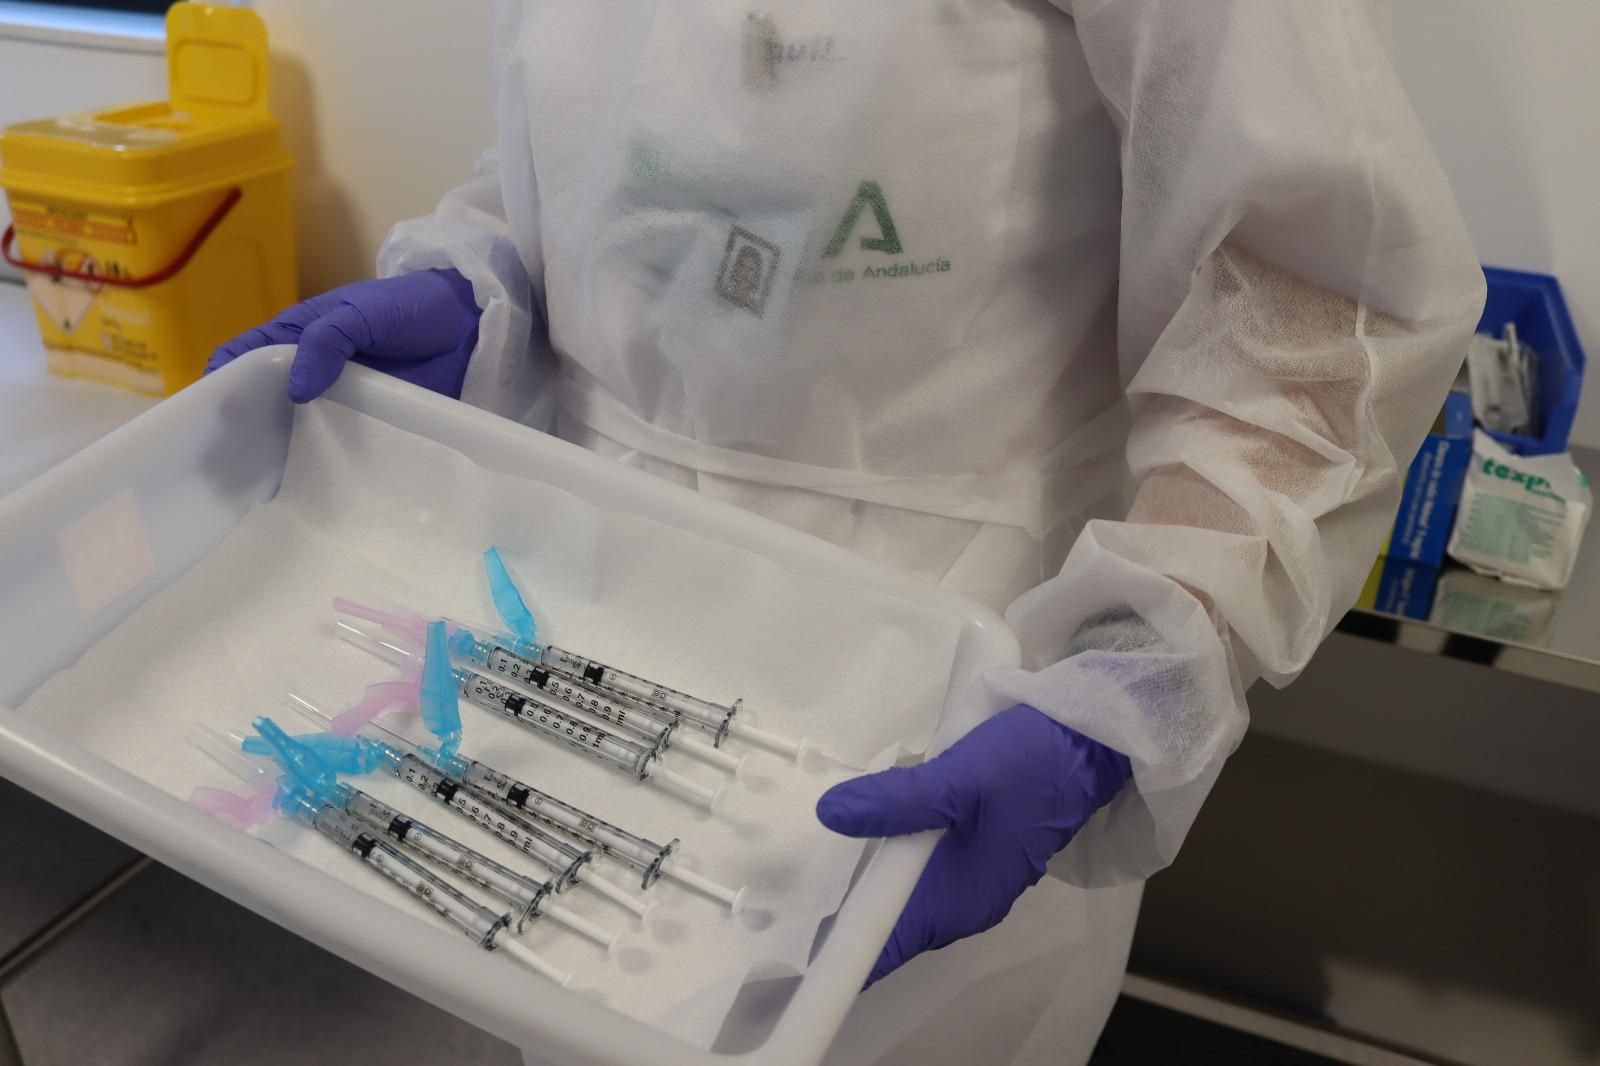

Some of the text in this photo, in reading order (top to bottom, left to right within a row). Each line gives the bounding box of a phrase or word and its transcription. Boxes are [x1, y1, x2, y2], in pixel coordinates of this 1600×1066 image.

[863, 256, 951, 280] Andalucía
[1483, 457, 1548, 492] texp
[498, 658, 507, 672] 0.1
[511, 663, 521, 677] 0.2
[475, 681, 486, 694] 0.1
[549, 681, 560, 696] 0.5
[562, 686, 572, 701] 0.6
[575, 693, 585, 708] 0.7
[589, 700, 599, 713] 0.8
[540, 709, 552, 723] 0.6
[602, 706, 612, 721] 0.9
[553, 714, 564, 729] 0.7
[566, 720, 578, 735] 0.8
[579, 726, 591, 741] 0.9
[592, 731, 606, 748] 1ml
[406, 768, 416, 782] 0.1
[418, 775, 429, 790] 0.2
